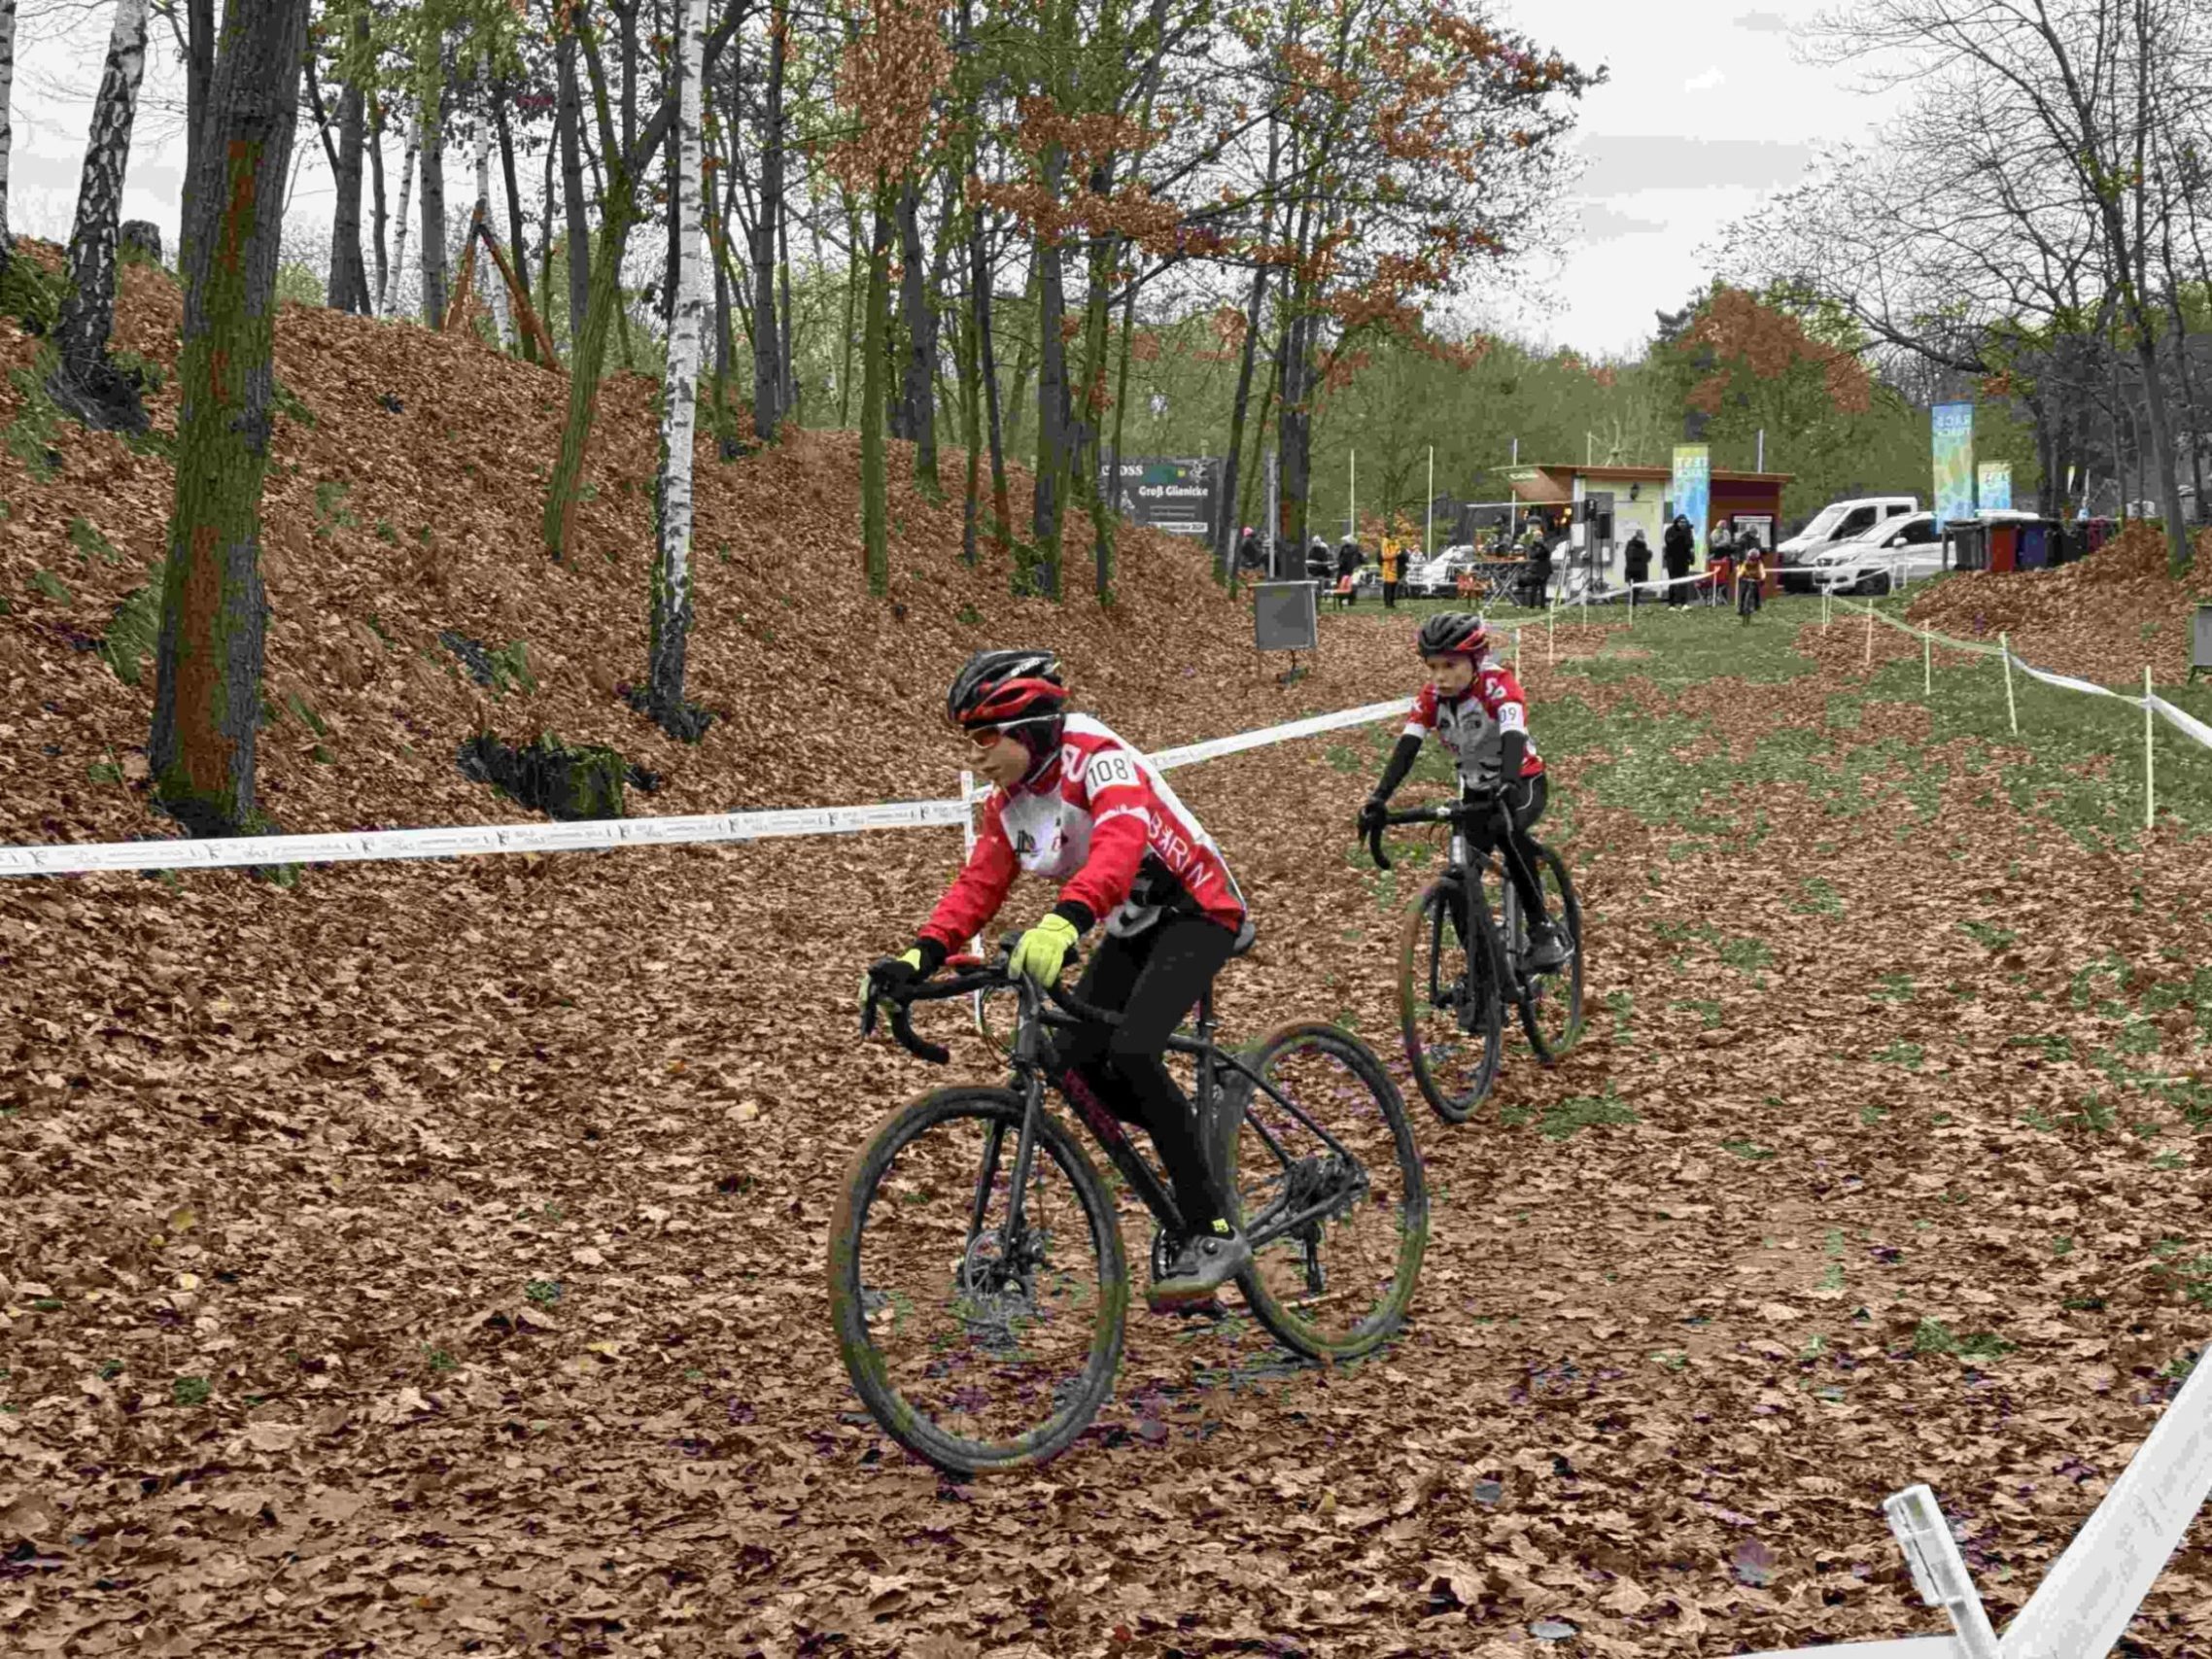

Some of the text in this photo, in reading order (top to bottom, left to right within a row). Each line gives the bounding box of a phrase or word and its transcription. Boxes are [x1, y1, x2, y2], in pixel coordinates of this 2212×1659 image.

[1101, 465, 1144, 477] COSS
[1138, 485, 1209, 498] Groß Glienicke
[1089, 758, 1129, 787] 108
